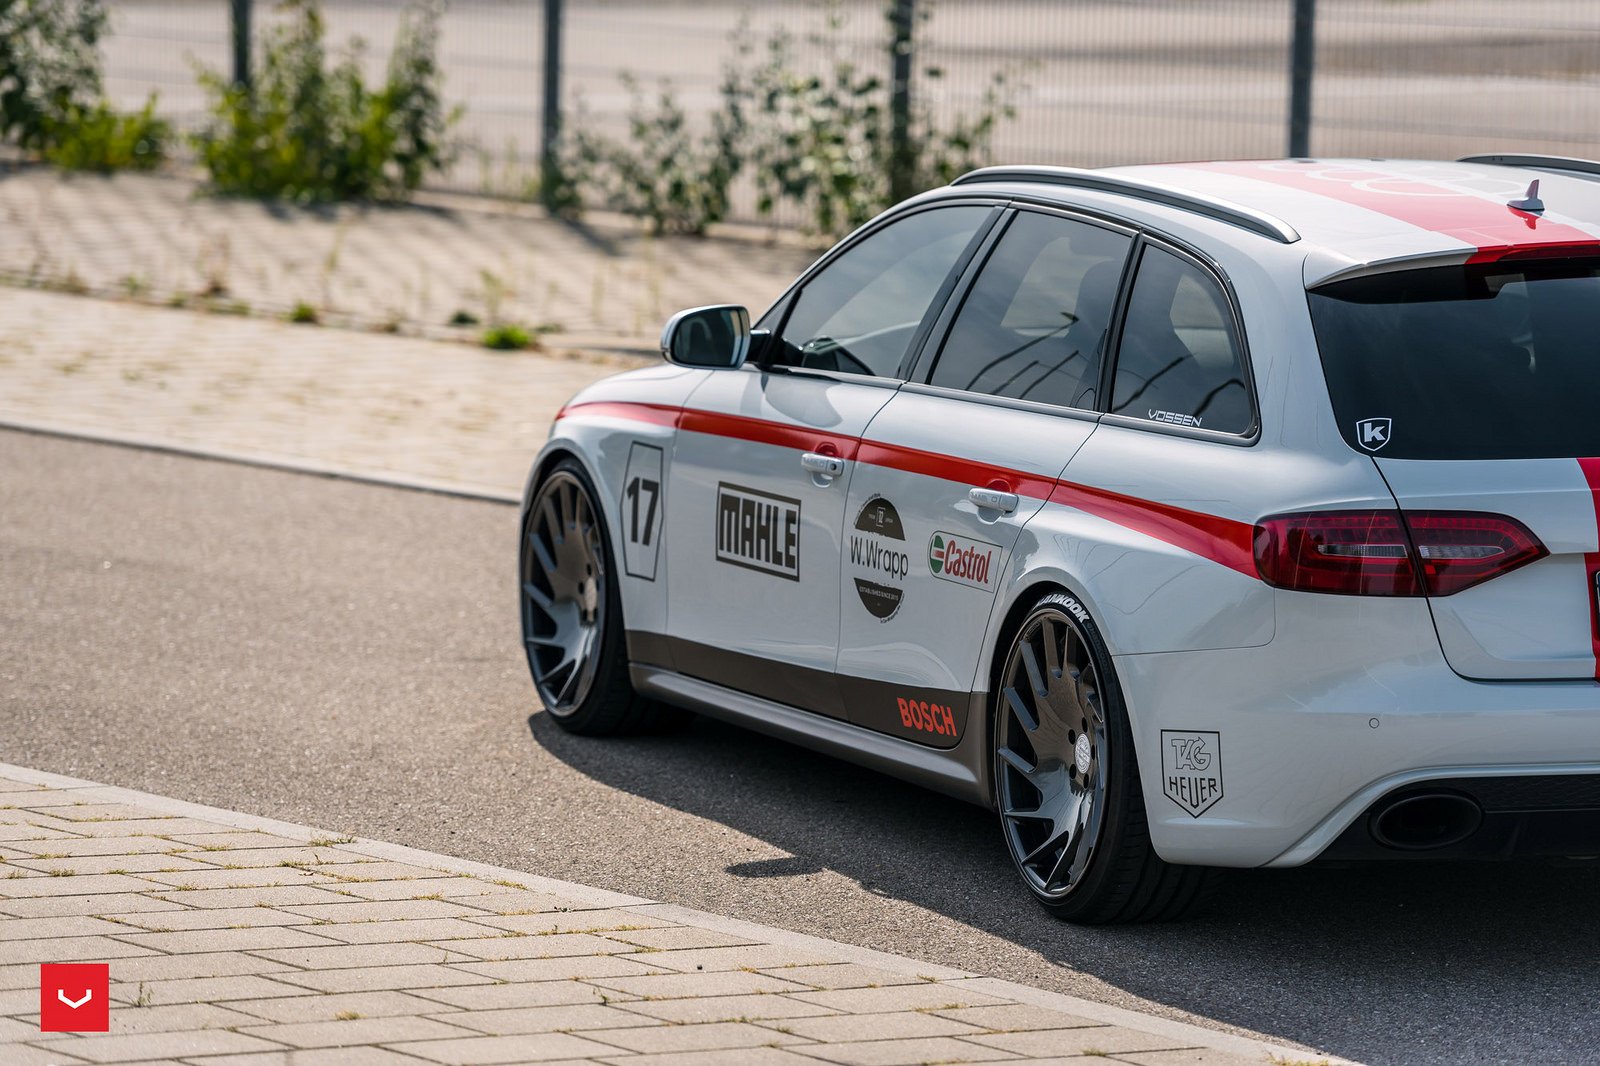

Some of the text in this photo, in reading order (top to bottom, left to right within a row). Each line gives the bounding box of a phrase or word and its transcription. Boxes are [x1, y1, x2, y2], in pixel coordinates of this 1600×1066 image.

[1147, 408, 1203, 428] VOSSEN
[626, 476, 660, 547] 17
[719, 493, 797, 570] MAHLE
[850, 535, 909, 581] W.Wrapp
[944, 540, 992, 584] Castrol
[896, 696, 958, 737] BOSCH
[1170, 736, 1212, 772] TAG
[1168, 776, 1218, 809] HEUER
